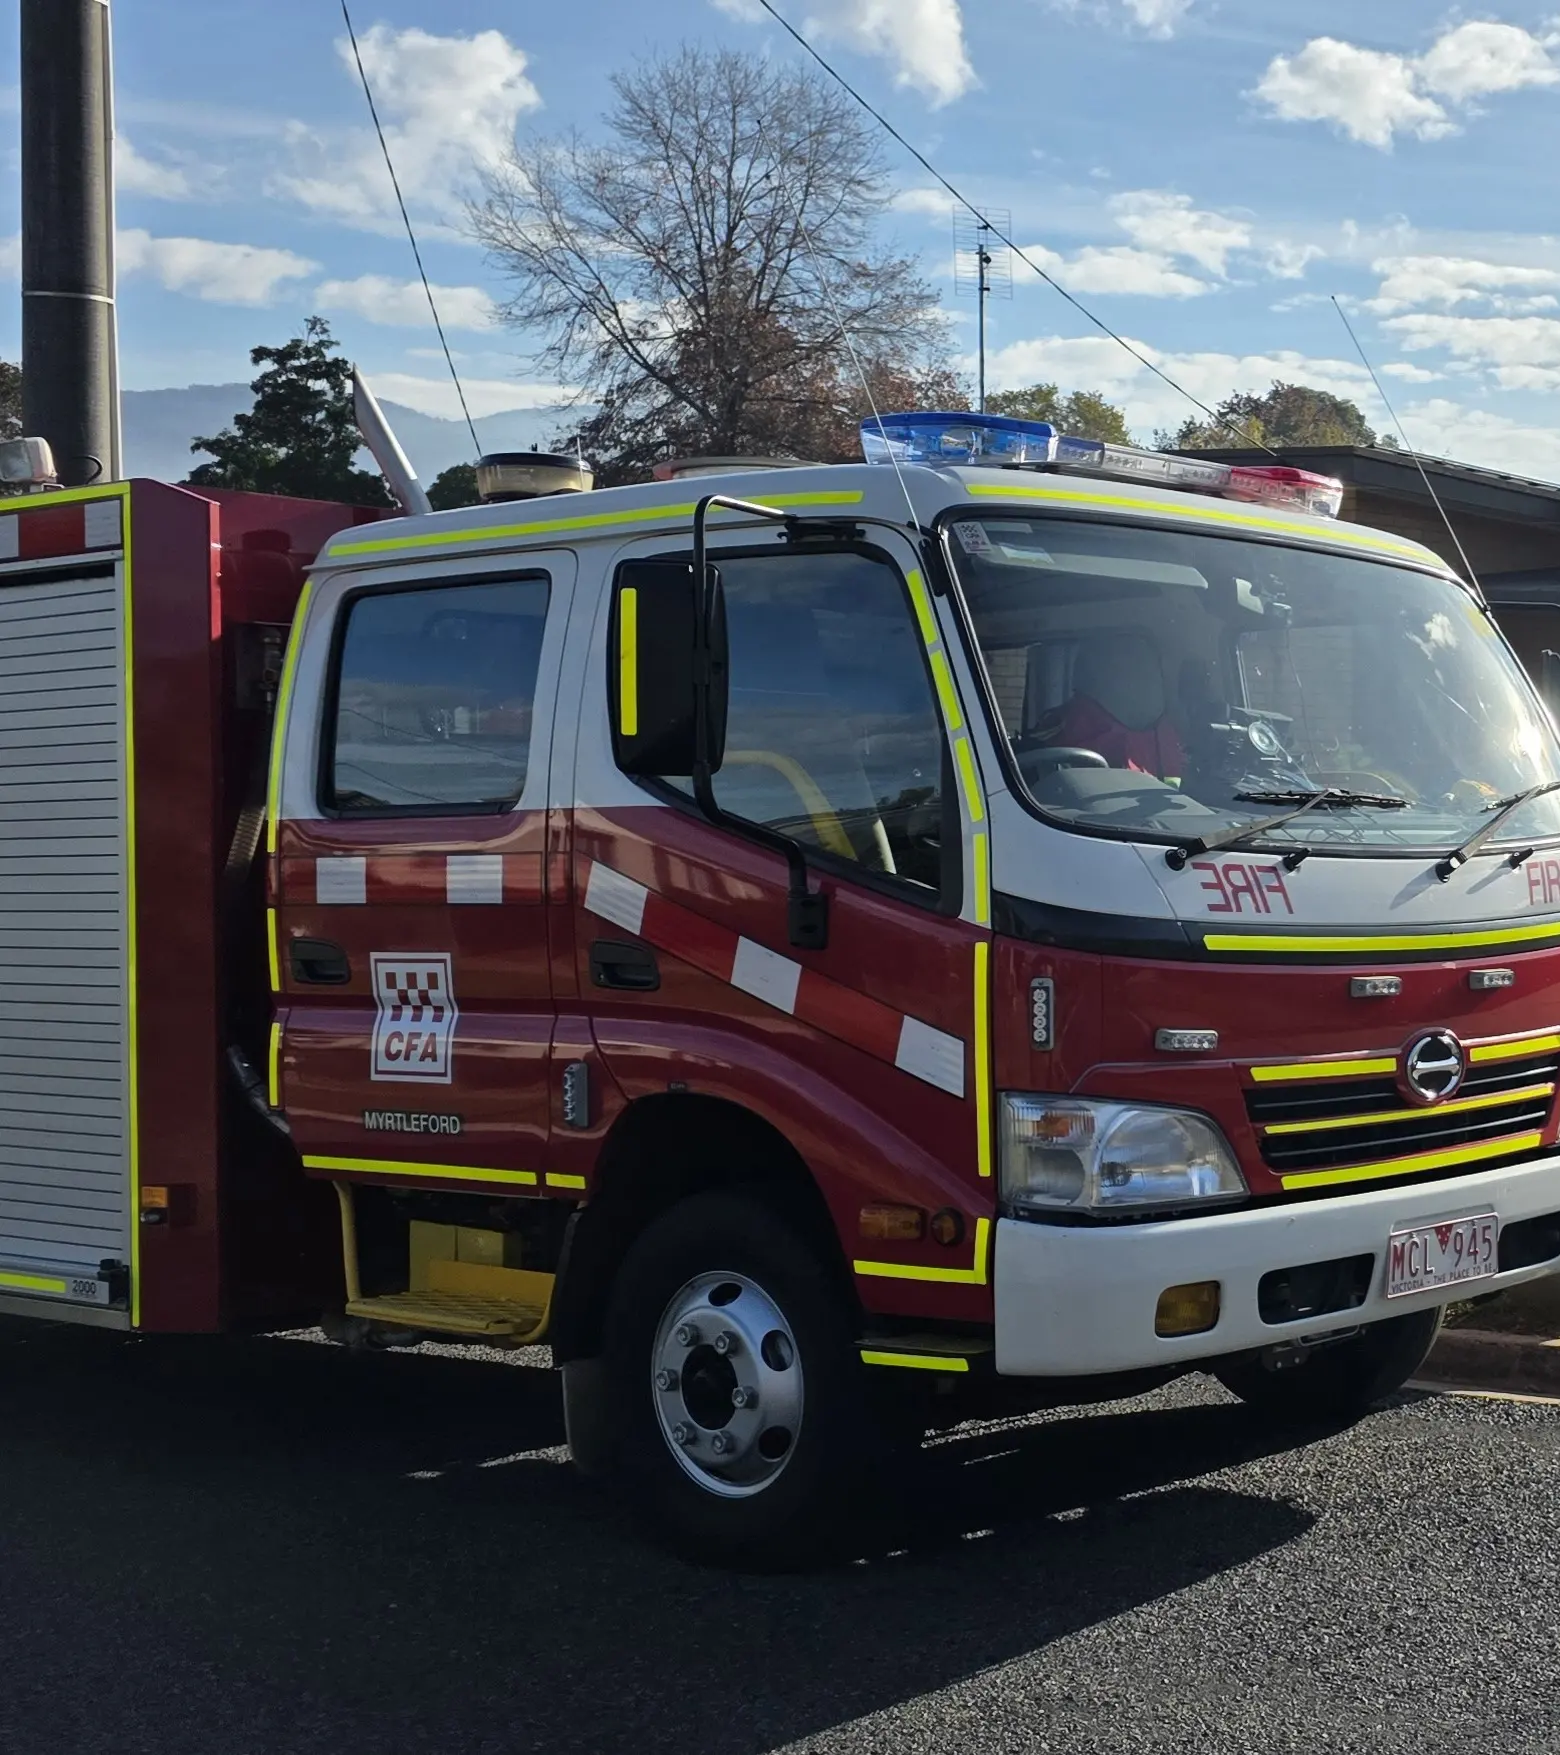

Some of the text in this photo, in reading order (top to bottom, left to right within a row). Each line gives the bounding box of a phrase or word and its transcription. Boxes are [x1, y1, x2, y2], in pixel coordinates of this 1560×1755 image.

[384, 1030, 438, 1062] CFA
[364, 1111, 460, 1134] MYRTLEFORD
[1392, 1225, 1492, 1282] MCL 945
[71, 1279, 97, 1295] 2000
[1391, 1280, 1424, 1294] VICTORIA
[1434, 1274, 1446, 1284] THE
[1450, 1267, 1470, 1281] PLACE
[1473, 1266, 1481, 1275] TO
